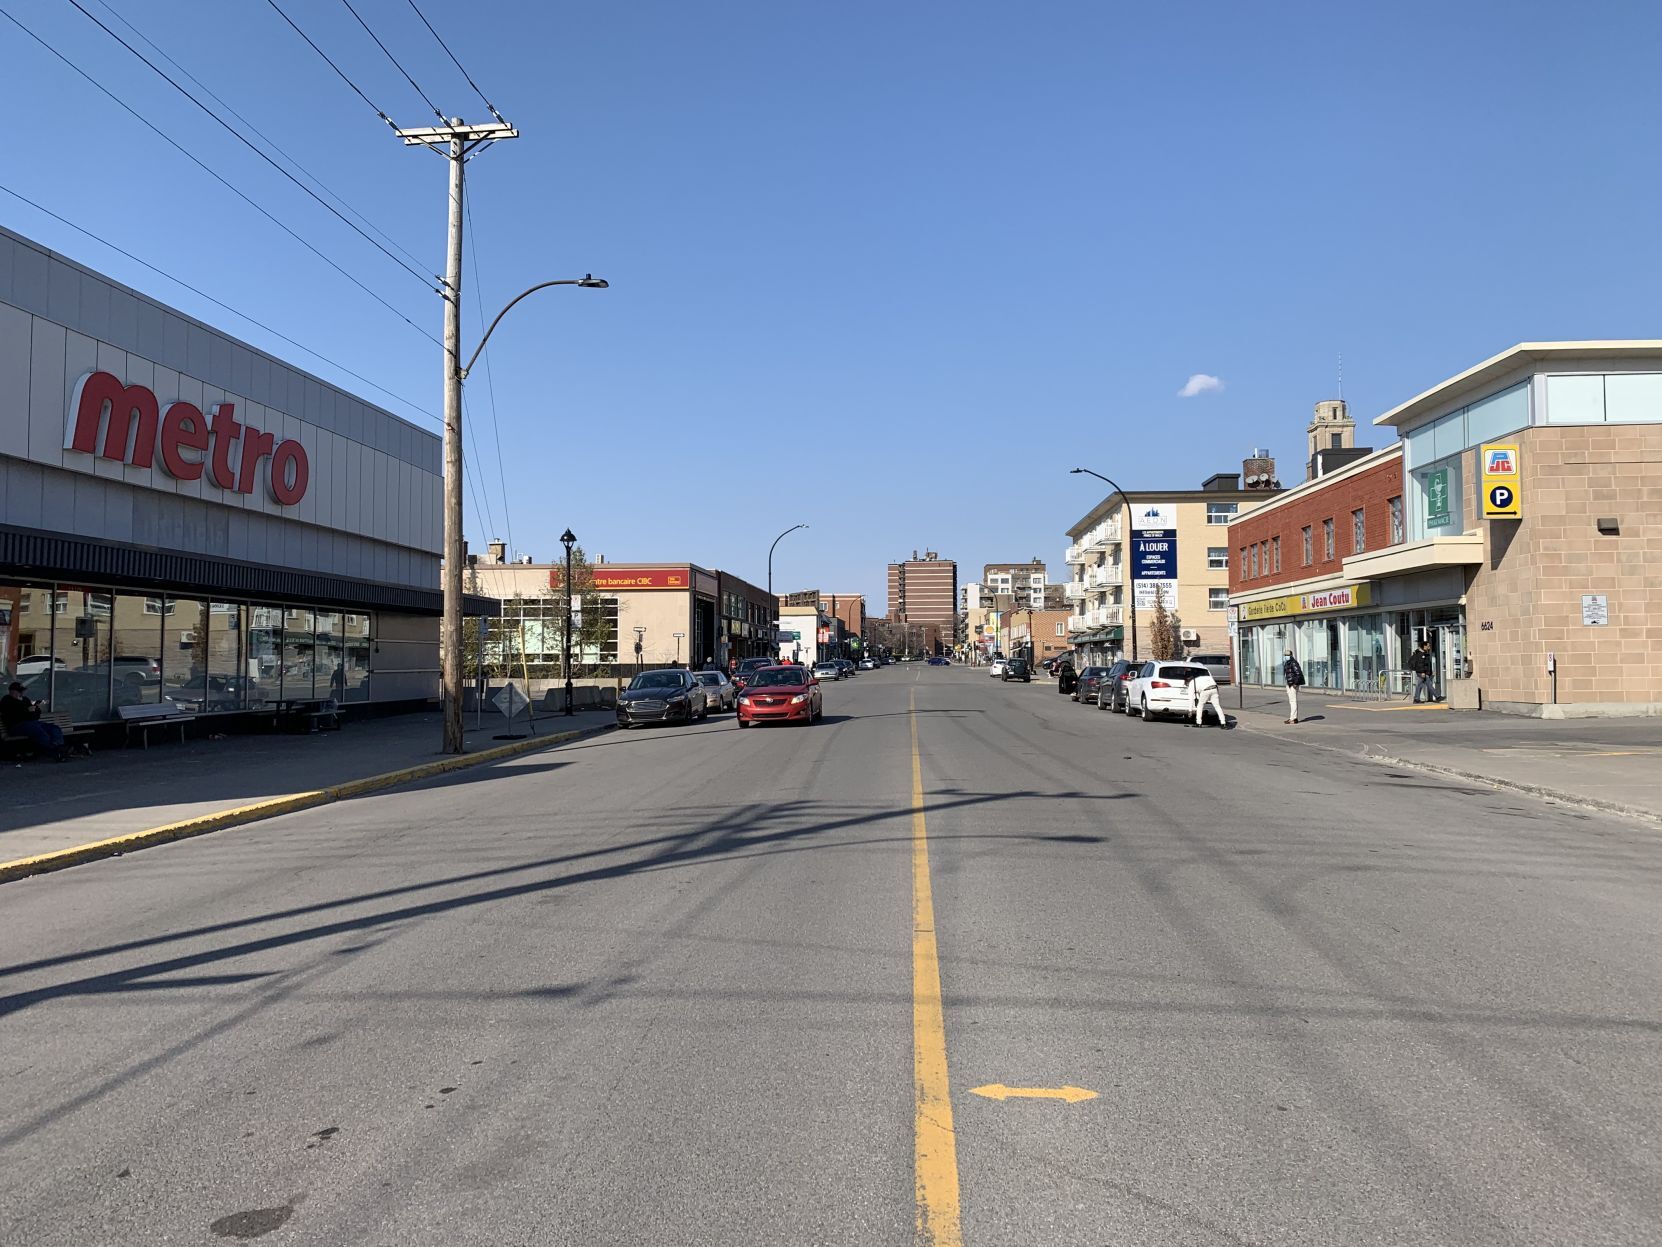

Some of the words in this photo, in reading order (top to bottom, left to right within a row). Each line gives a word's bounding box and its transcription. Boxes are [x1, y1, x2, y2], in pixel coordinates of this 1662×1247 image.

[68, 371, 309, 506] metro
[1496, 490, 1508, 504] P
[1139, 541, 1145, 551] À
[1146, 543, 1169, 551] LOUER
[608, 577, 636, 585] bancaire
[637, 577, 652, 585] CIBC
[1312, 595, 1327, 608] Jean
[1329, 592, 1349, 605] Coutu
[1481, 621, 1494, 631] 6624
